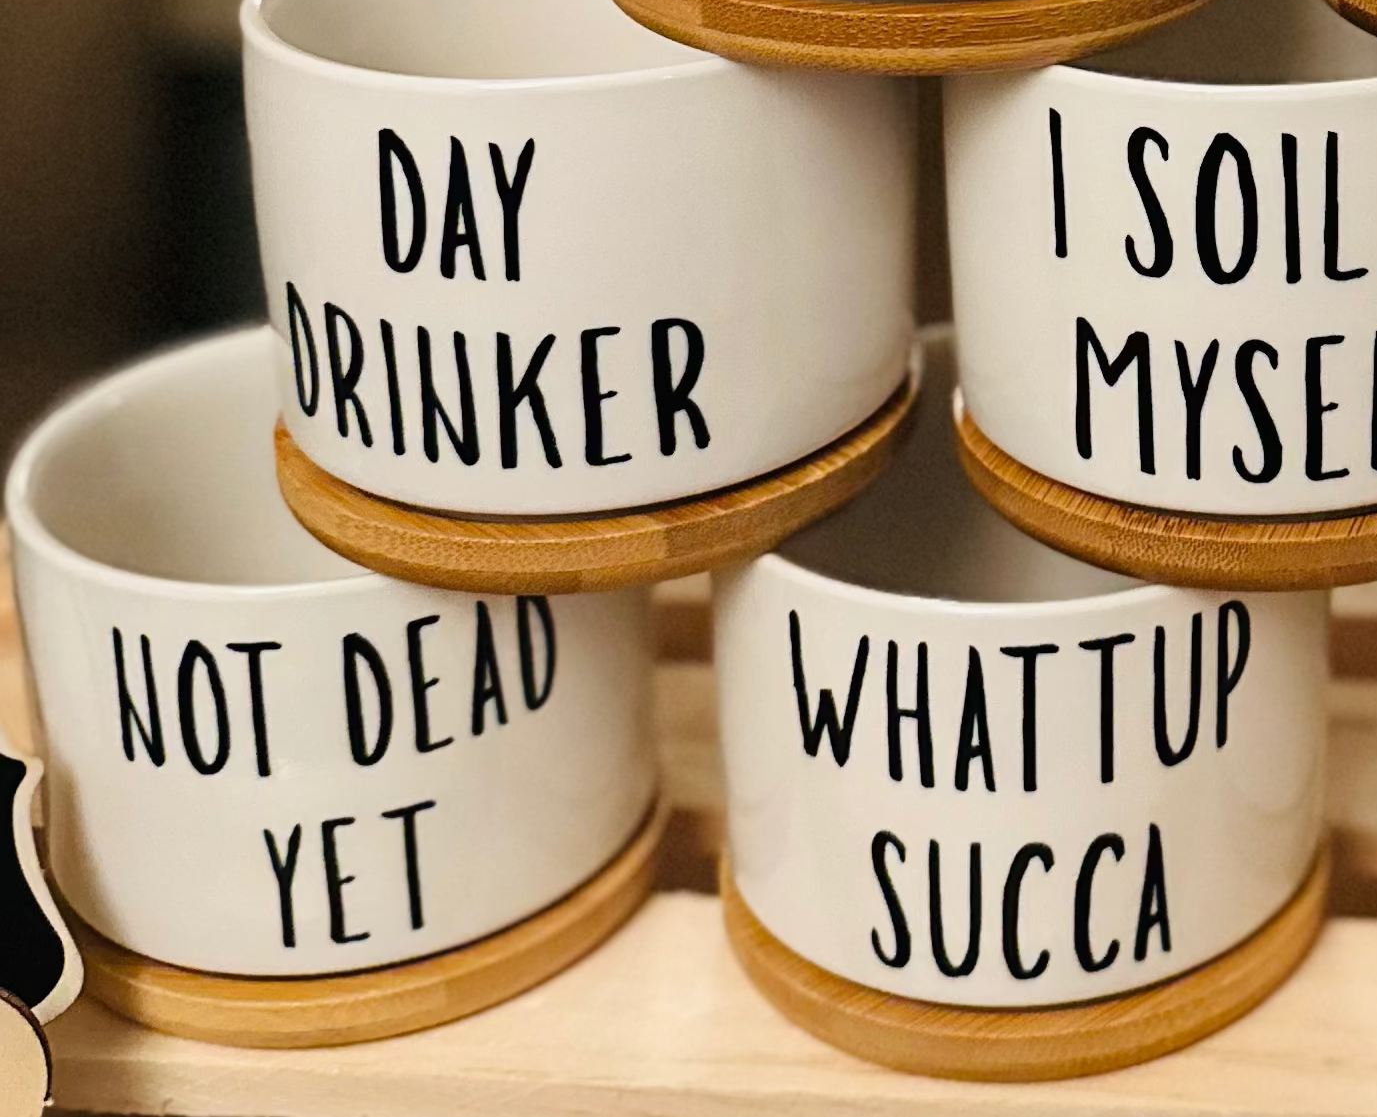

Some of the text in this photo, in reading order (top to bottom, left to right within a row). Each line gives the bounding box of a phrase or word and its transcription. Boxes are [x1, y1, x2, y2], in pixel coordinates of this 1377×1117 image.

[378, 128, 535, 282] DAY
[1048, 107, 1068, 259] I
[285, 281, 711, 470] DRINKER
[111, 595, 556, 779] NOT DEAD
[263, 800, 437, 948] YET
[871, 822, 1172, 980] SUCCA
